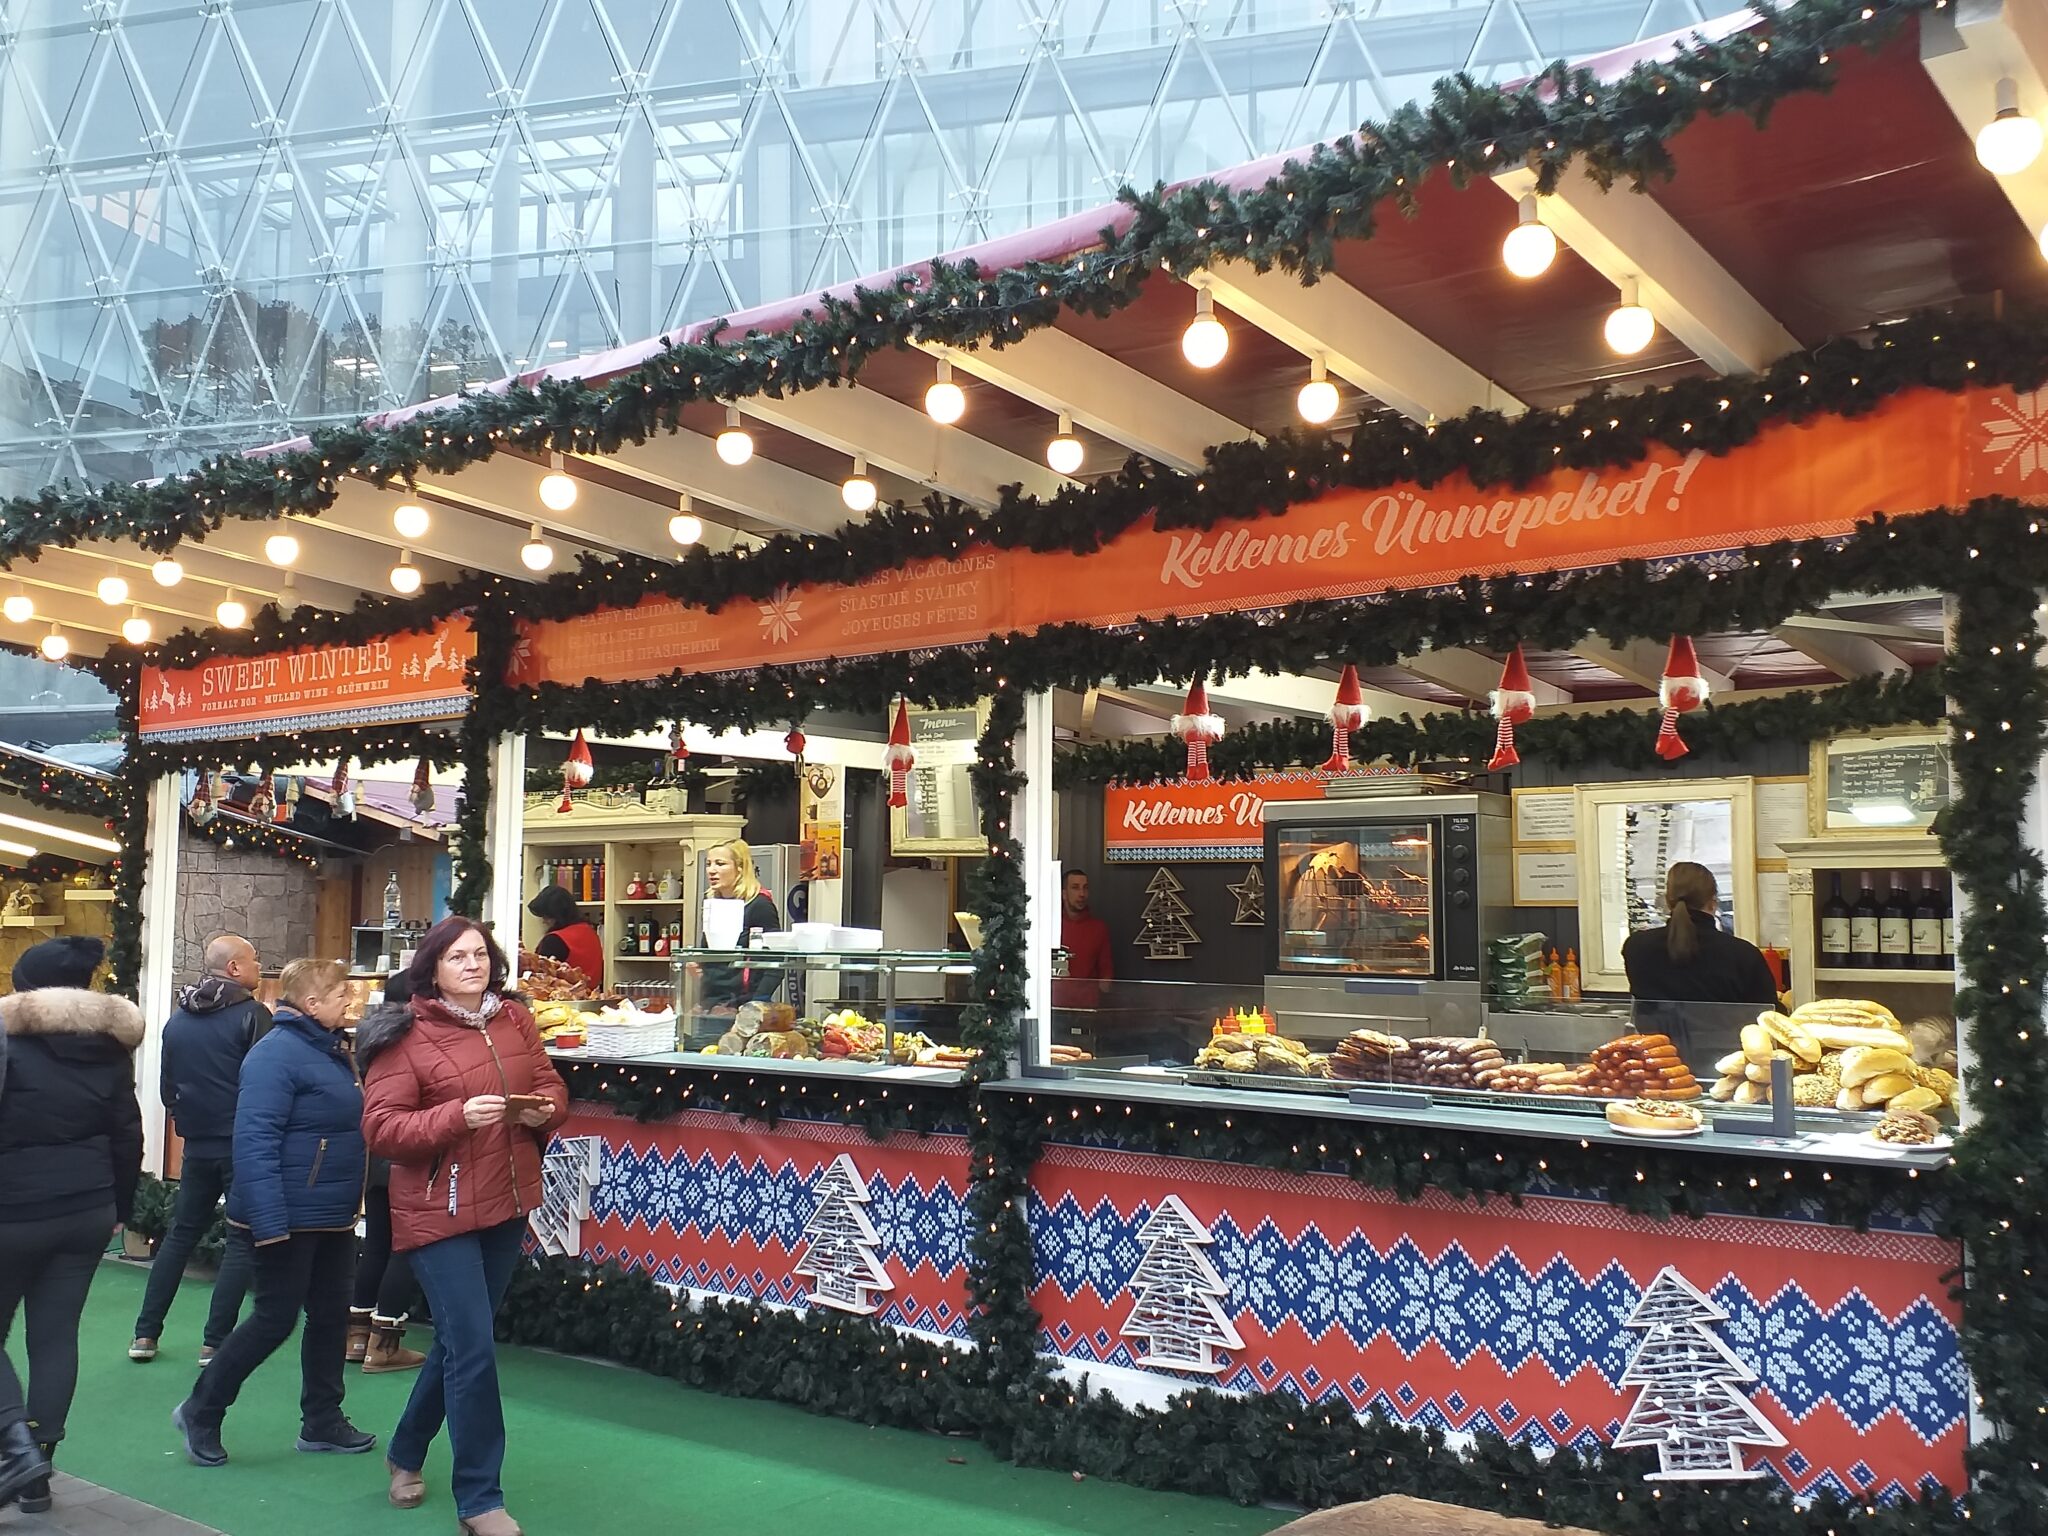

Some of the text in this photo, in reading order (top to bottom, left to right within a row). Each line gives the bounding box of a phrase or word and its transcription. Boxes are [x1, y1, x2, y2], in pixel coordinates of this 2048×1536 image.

[1160, 448, 1705, 588] Kellemes Ünnepeket!
[894, 554, 996, 582] VACACIONES
[914, 580, 980, 603] SVÁTKY
[579, 608, 620, 627] HAPPY
[650, 620, 698, 639] FERIEN
[842, 604, 978, 636] JOYEUSES FÊTES
[637, 637, 721, 662] ПРАЗДНИКИ
[202, 641, 392, 697] SWEET WINTER
[201, 698, 240, 711] FORRALT
[264, 690, 301, 704] MULLED
[304, 688, 329, 699] WINE
[336, 679, 390, 695] GLÜHWEIN
[1123, 799, 1227, 832] Kellemes
